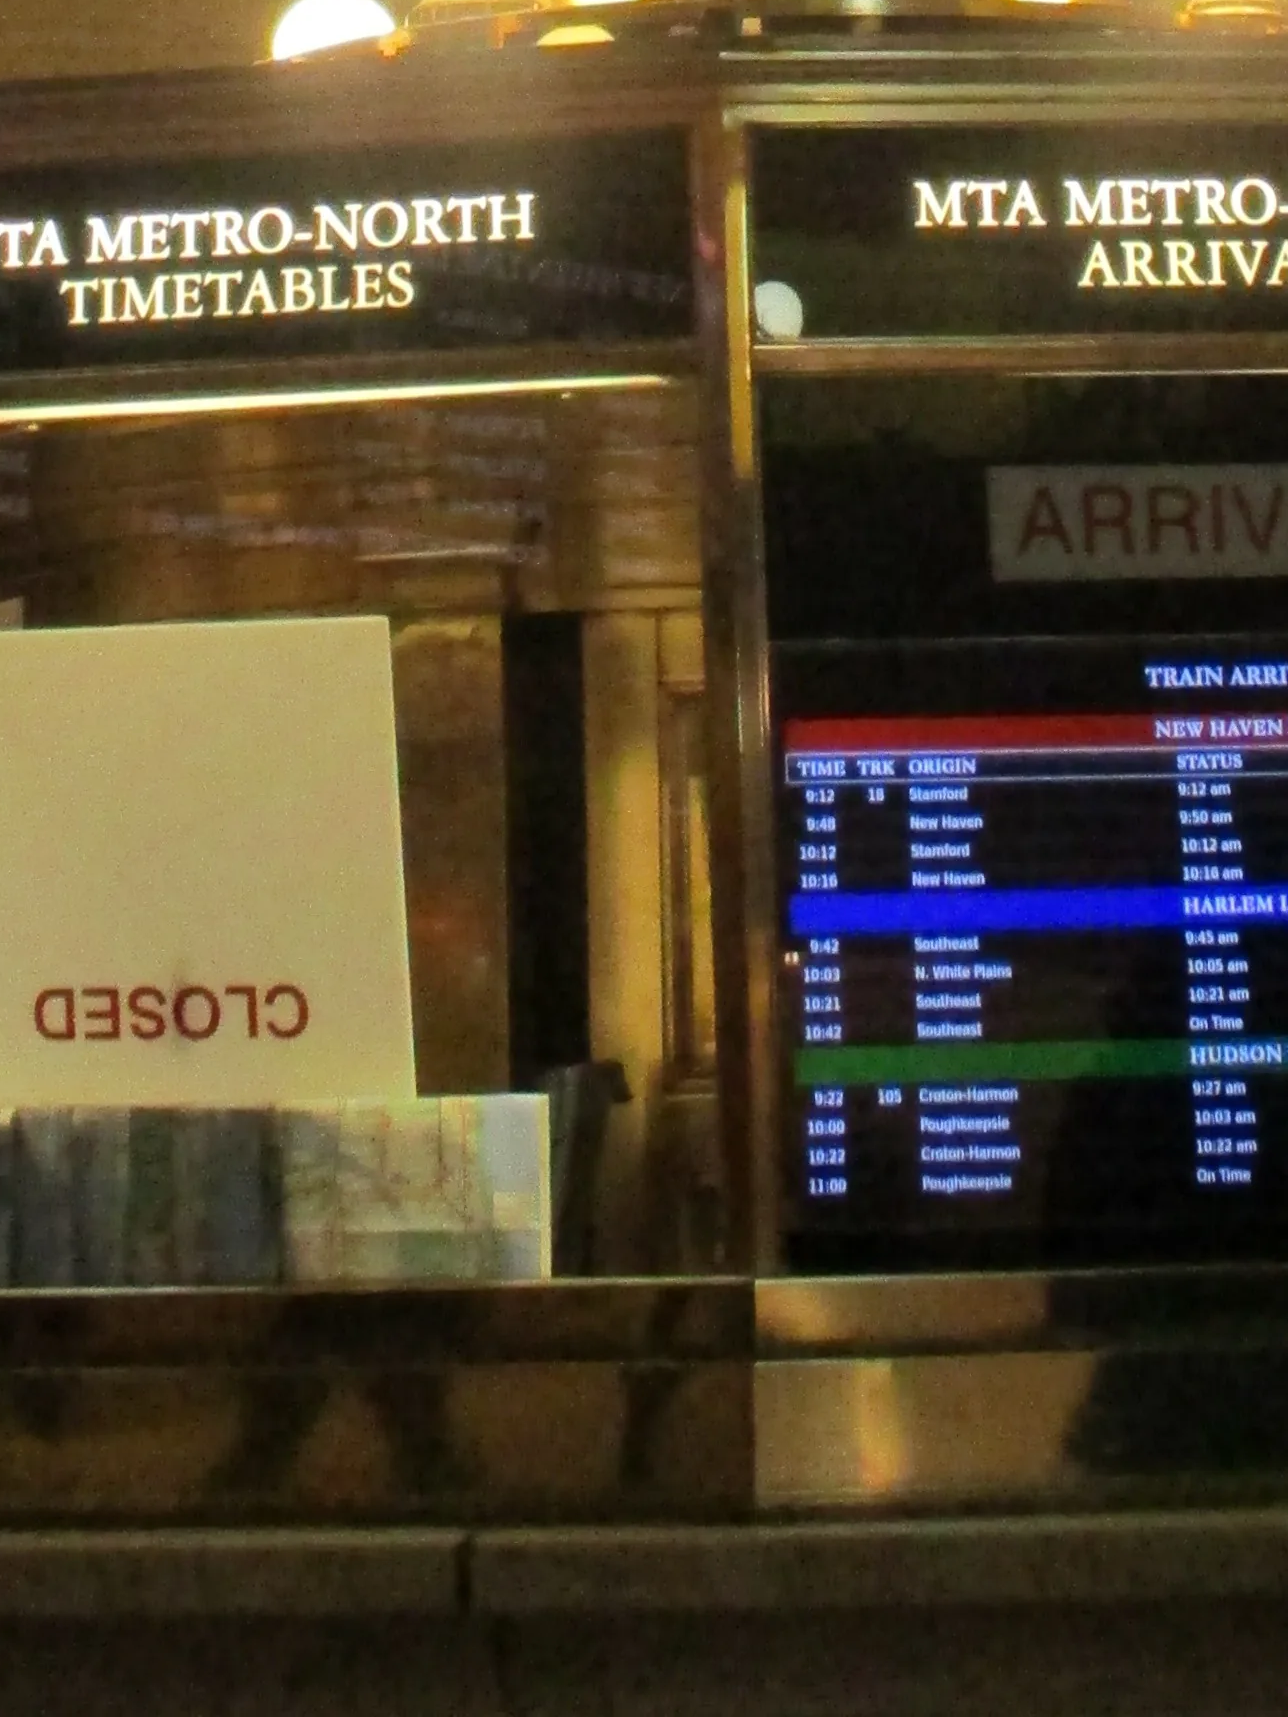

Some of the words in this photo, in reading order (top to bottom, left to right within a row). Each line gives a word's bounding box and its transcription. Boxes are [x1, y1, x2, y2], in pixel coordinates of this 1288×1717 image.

[914, 180, 1047, 229] MTA
[85, 193, 536, 263] METRO-NORTH
[60, 261, 416, 326] TIMETABLES
[1145, 666, 1223, 688] TRAIN
[1155, 720, 1203, 738] NEW
[1210, 719, 1283, 737] HAVEN
[797, 760, 846, 777] TIME
[857, 759, 895, 776] TRK
[908, 757, 977, 775] ORIGIN
[1176, 753, 1243, 769] STATUS
[909, 786, 968, 801] Stamford
[1178, 782, 1207, 796] 9:12
[1210, 783, 1231, 796] am
[910, 816, 938, 830] New
[941, 815, 984, 829] Haven
[1179, 810, 1208, 825] 9:50
[1212, 811, 1232, 824] am
[799, 844, 837, 860] 10:12
[911, 843, 970, 858] Stamford
[1181, 838, 1217, 853] 10:12
[1221, 839, 1242, 853] am
[912, 872, 940, 887] New
[944, 871, 985, 886] Haven
[1222, 867, 1243, 880] am
[1183, 896, 1274, 916] HARLEM
[810, 938, 839, 954] 9:42
[914, 936, 979, 952] Southeast
[1218, 932, 1239, 945] am
[915, 966, 929, 981] N.
[932, 965, 971, 980] White
[973, 964, 1012, 979] Plains
[1227, 959, 1248, 973] am
[804, 996, 841, 1012] 10:21
[916, 993, 981, 1009] Southeast
[1189, 986, 1225, 1002] 10:21
[1228, 988, 1249, 1002] am
[33, 984, 310, 1041] CLOSED
[805, 1024, 842, 1041] 10:42
[917, 1022, 982, 1038] Southeast
[1189, 1017, 1208, 1031] On
[1211, 1015, 1244, 1031] Time
[1189, 1043, 1282, 1065] HUDSON
[919, 1086, 1019, 1104] Croton-Harmon
[1225, 1081, 1246, 1095] am
[920, 1115, 1010, 1134] Poughkeepsie
[1235, 1111, 1256, 1124] am
[921, 1145, 1021, 1162] Croton-Harmon
[1236, 1139, 1257, 1153] am
[922, 1174, 1012, 1194] Poughkeepsie
[1196, 1168, 1216, 1183] On
[1219, 1167, 1251, 1183] Time
